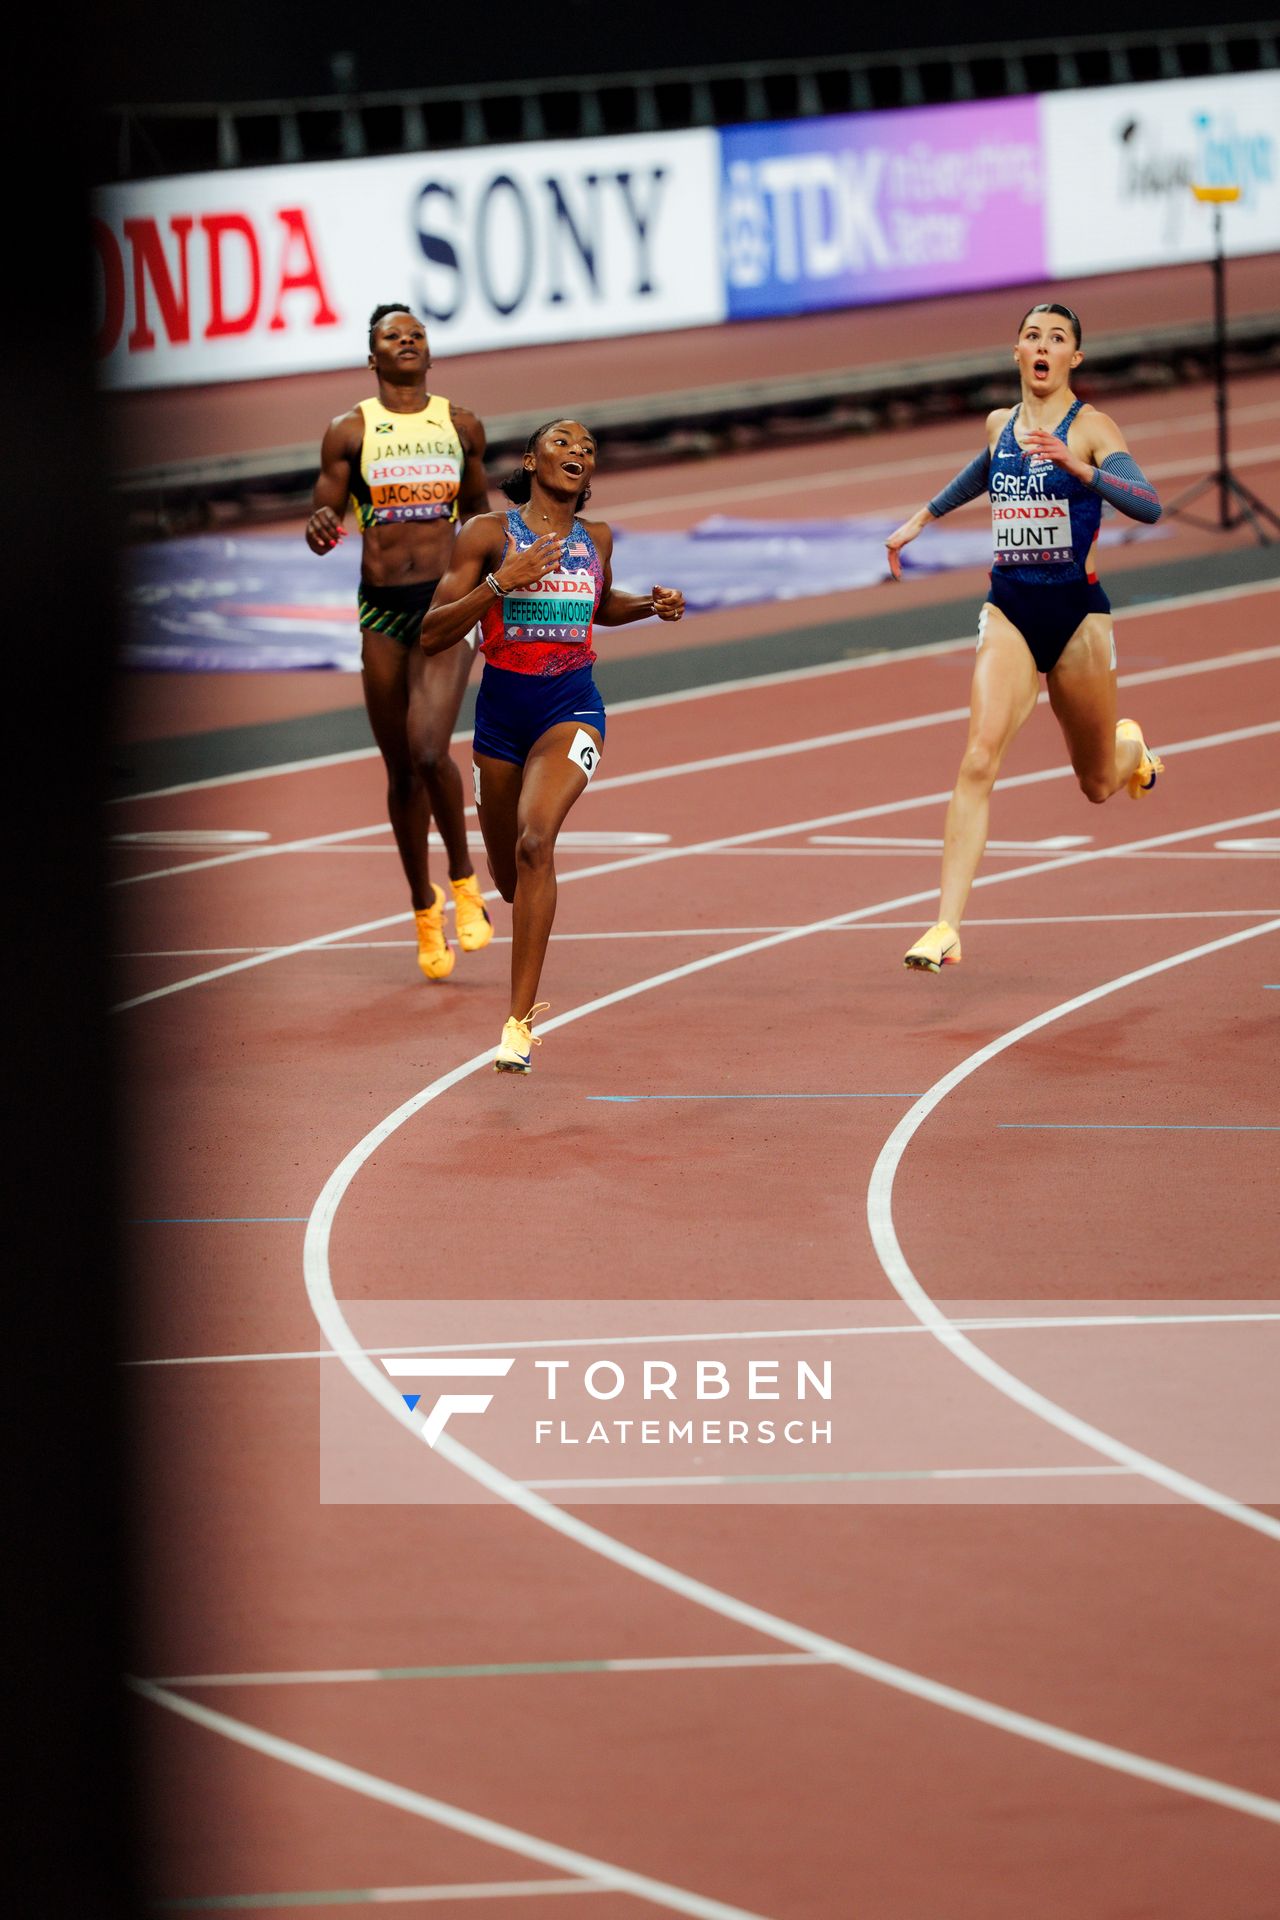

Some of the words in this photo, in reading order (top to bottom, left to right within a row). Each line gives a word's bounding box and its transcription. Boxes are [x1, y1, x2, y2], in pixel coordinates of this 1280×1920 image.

[761, 146, 891, 282] TDK
[411, 168, 668, 323] SONY
[88, 207, 340, 360] ONDA
[374, 442, 456, 461] JAMAICA
[373, 464, 456, 479] HONDA
[992, 472, 1048, 494] GREAT
[378, 483, 456, 504] JACKSON
[994, 506, 1067, 520] HONDA
[997, 527, 1058, 547] HUNT
[514, 580, 593, 594] ONDA
